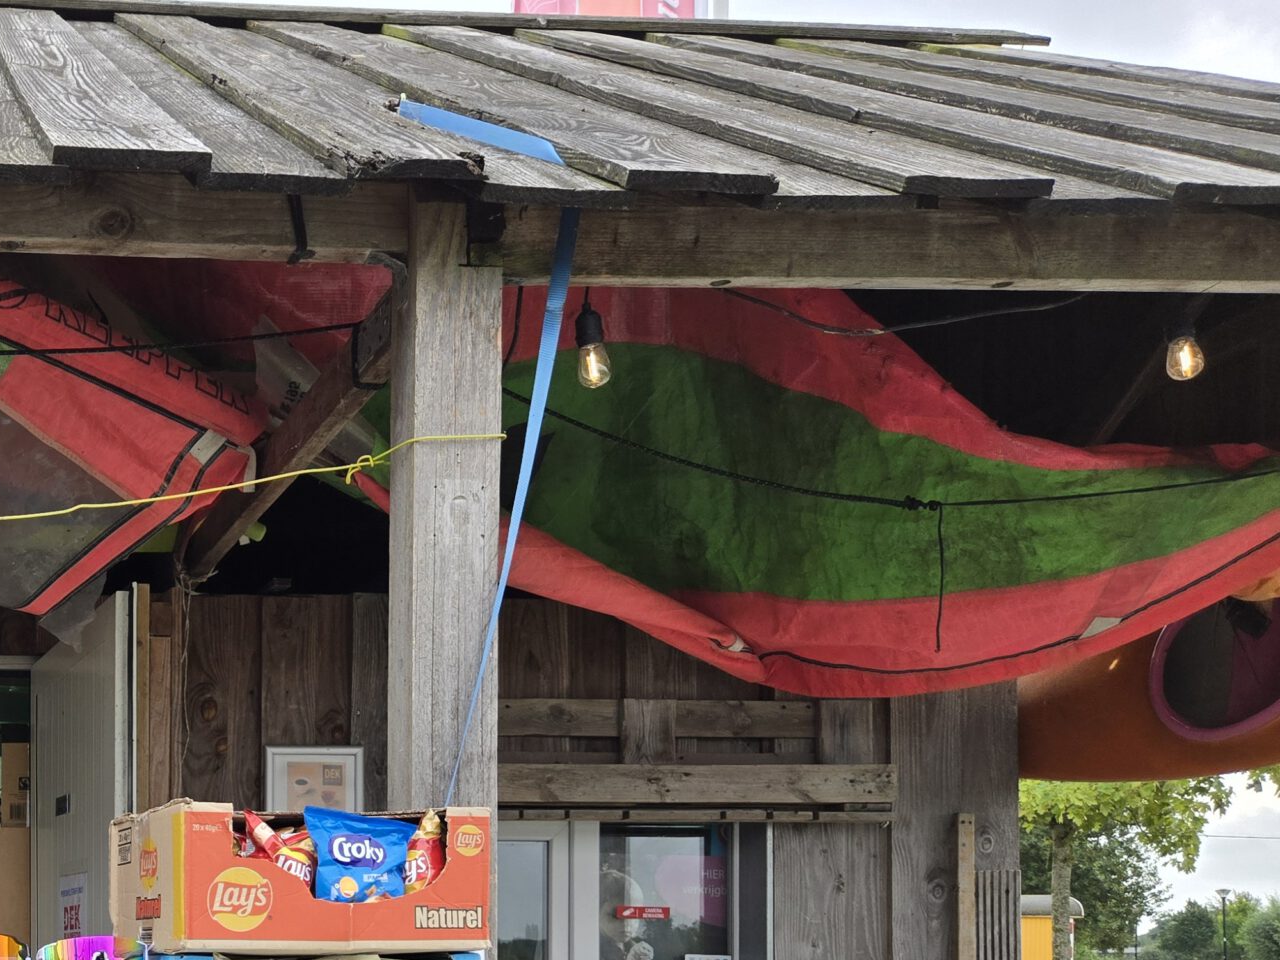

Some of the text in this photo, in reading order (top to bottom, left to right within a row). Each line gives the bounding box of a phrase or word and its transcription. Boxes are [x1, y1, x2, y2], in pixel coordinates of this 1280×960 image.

[332, 837, 384, 864] Croky
[212, 883, 269, 917] Lay's
[414, 906, 483, 929] Naturel
